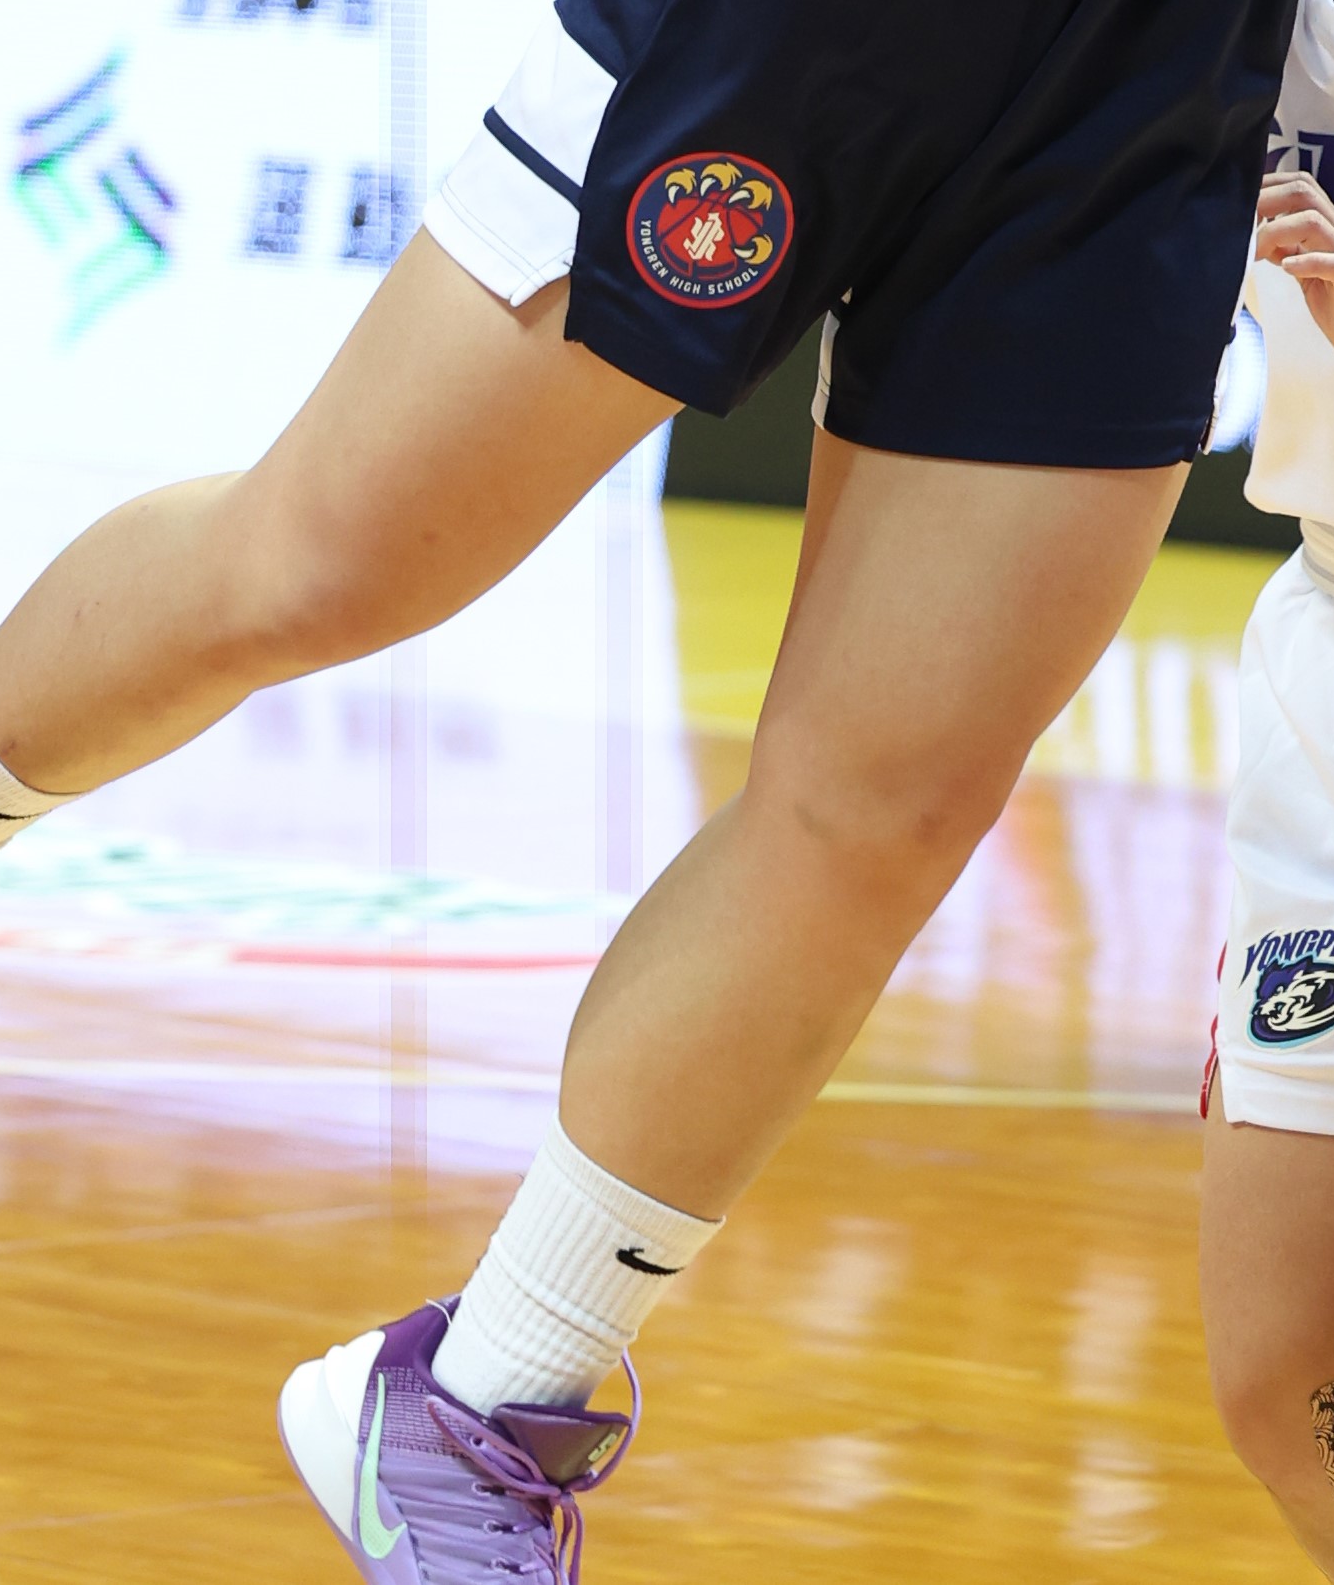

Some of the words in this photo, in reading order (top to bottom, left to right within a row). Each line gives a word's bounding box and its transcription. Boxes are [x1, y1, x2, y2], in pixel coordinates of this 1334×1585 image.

[640, 219, 669, 279] YONGREN
[669, 275, 701, 295] HIGH
[707, 266, 760, 296] SCHOOL
